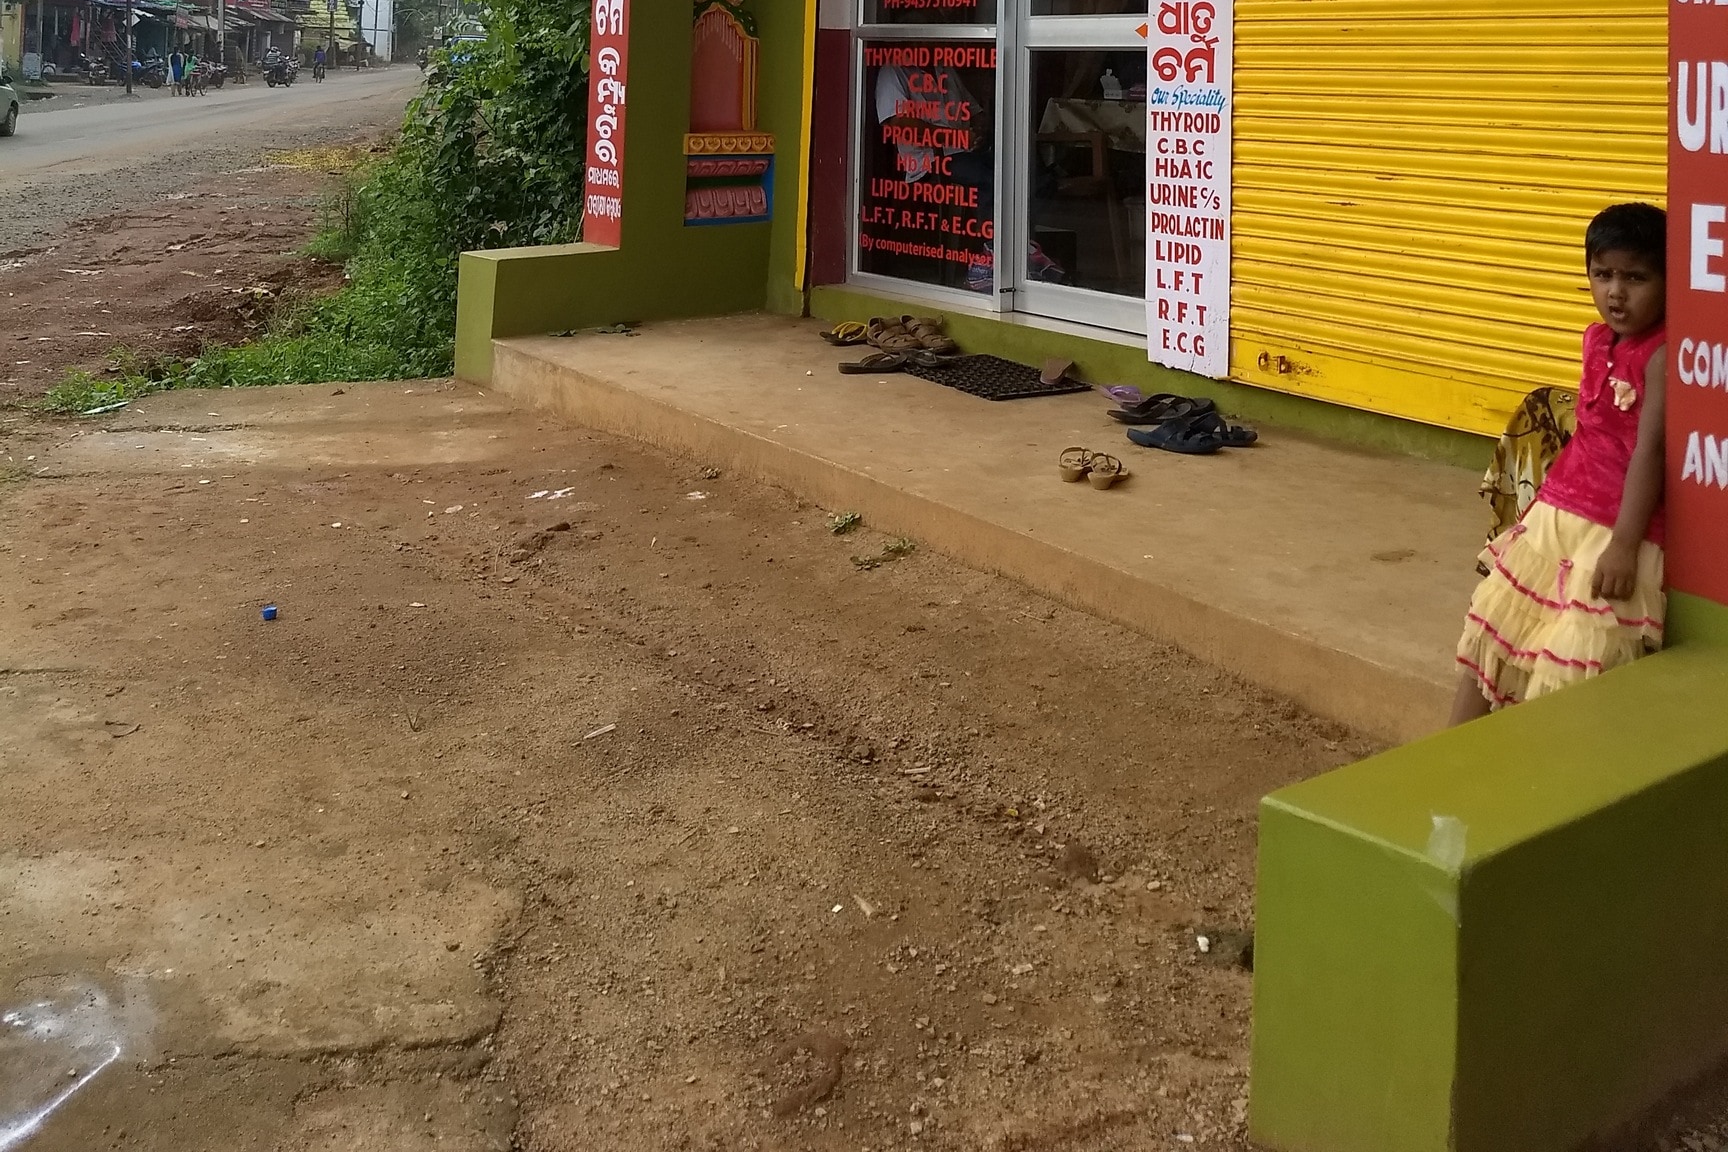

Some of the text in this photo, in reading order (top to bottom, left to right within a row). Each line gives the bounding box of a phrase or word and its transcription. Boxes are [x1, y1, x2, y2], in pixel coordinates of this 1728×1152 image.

[1157, 1, 1216, 44] ଧାତୁ
[864, 47, 997, 68] THYROID PROFILE
[1152, 36, 1219, 84] ଚର୍ମ
[908, 73, 949, 94] C.B.C
[895, 99, 972, 122] URINE C/S
[1150, 110, 1222, 135] THYROID
[883, 125, 970, 151] PROLACTIN
[1157, 137, 1206, 157] C.B.C
[871, 177, 979, 209] LIPID PROFILE
[1150, 183, 1198, 210] URINE
[941, 218, 950, 232] &
[952, 216, 994, 239] E.C.G
[1151, 211, 1225, 242] PROLACTIN
[875, 237, 944, 260] computerised
[1155, 239, 1203, 266] LIPID
[1156, 268, 1204, 295] L.F.T
[1158, 298, 1208, 326] R.F.T
[1162, 328, 1206, 357] E.C.G
